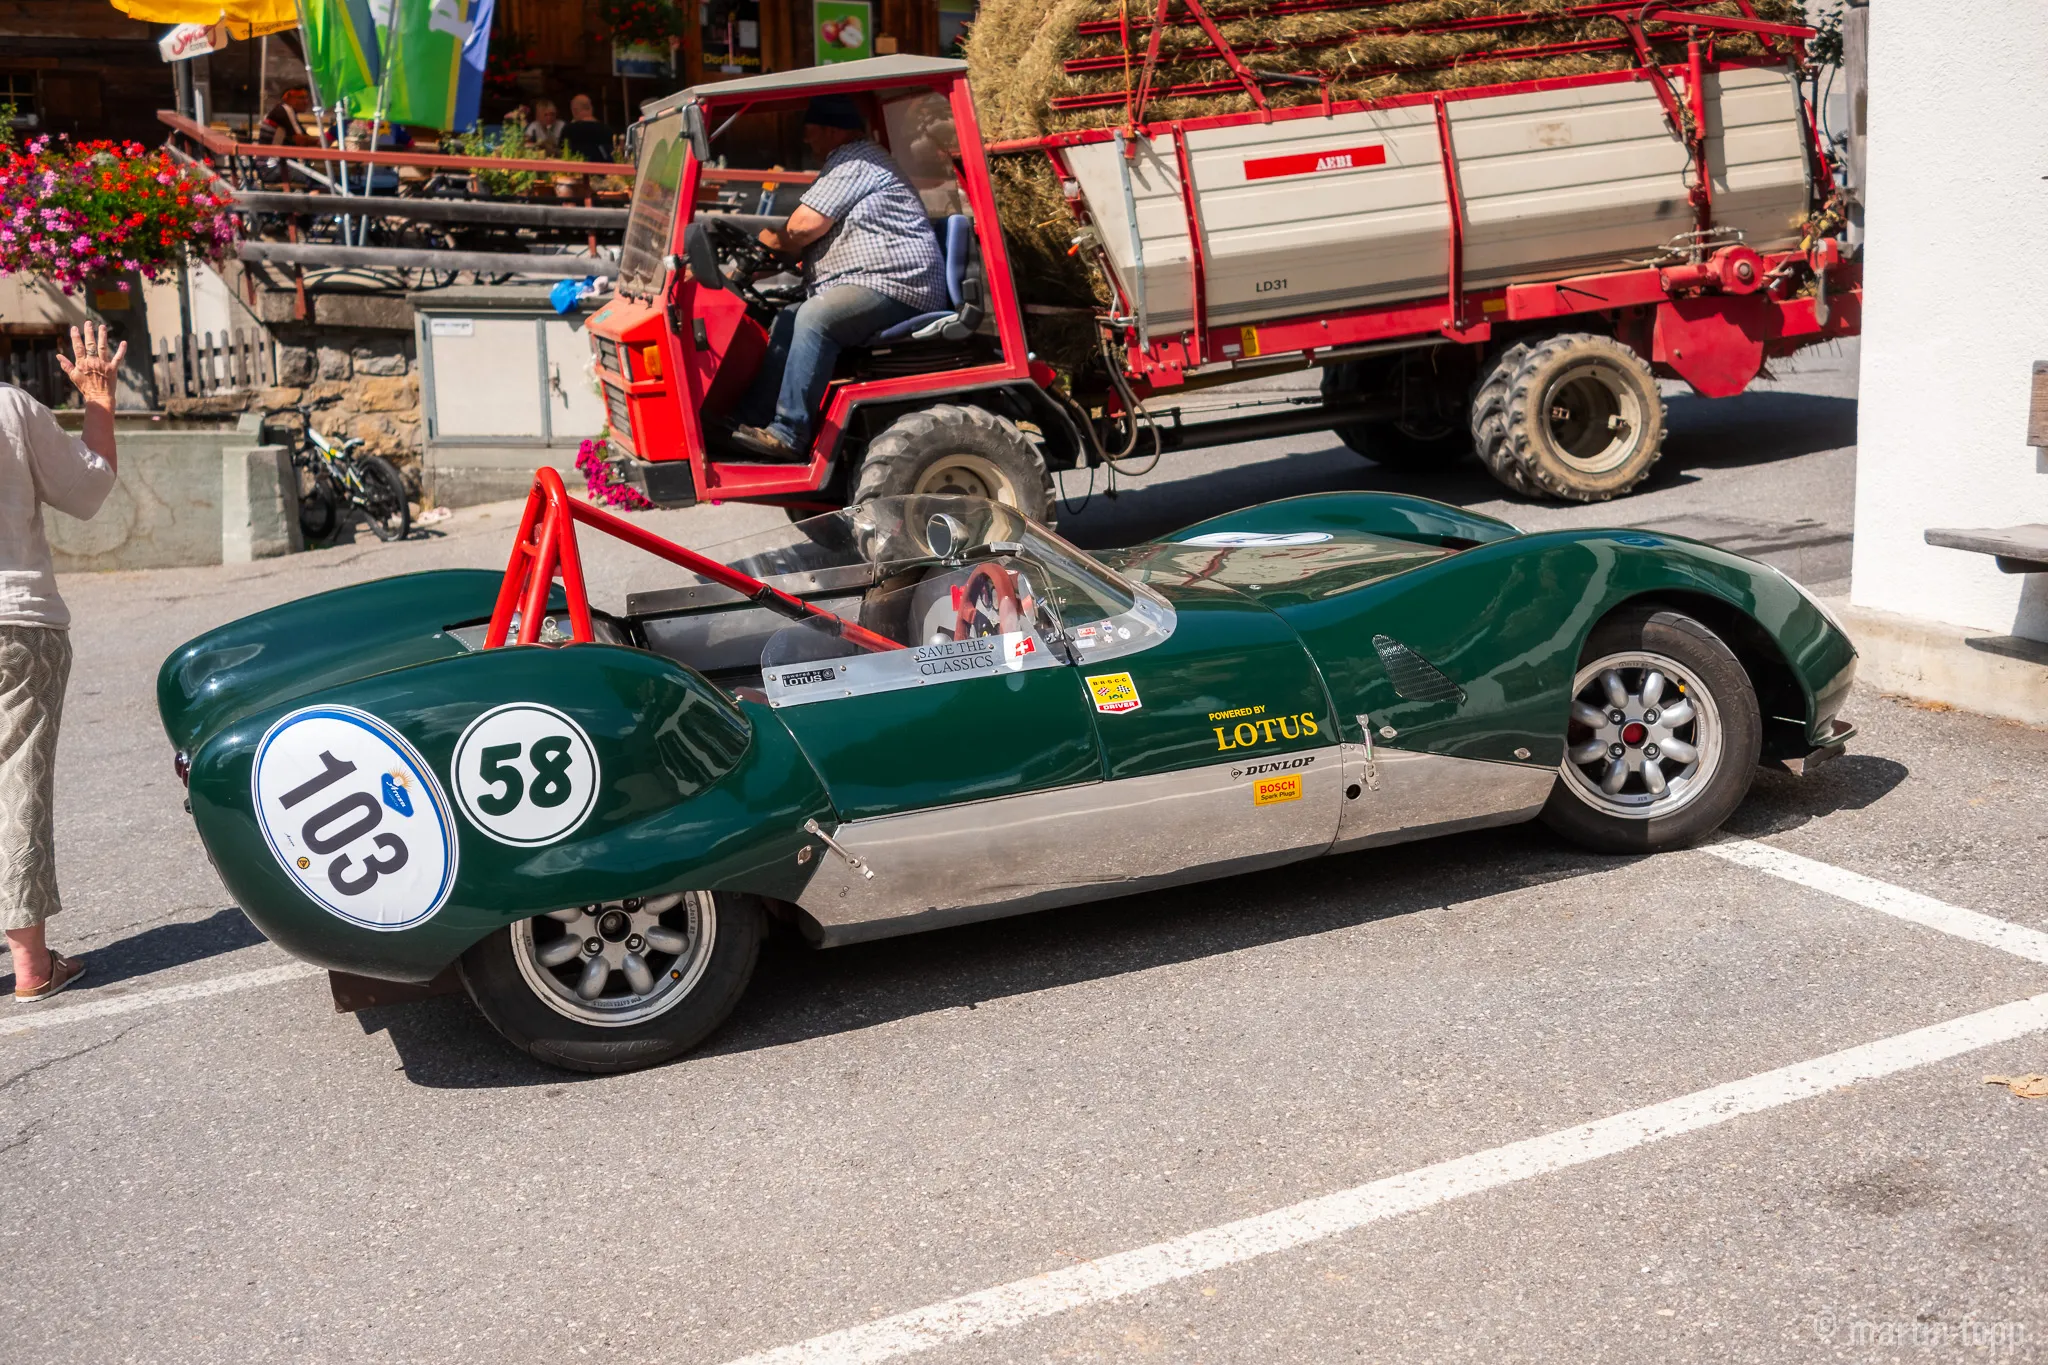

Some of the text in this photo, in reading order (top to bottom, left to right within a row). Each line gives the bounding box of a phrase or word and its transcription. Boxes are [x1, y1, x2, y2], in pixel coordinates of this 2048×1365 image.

[1316, 155, 1353, 170] AEBI
[1256, 279, 1287, 293] LD31
[918, 639, 987, 659] SAVE THE
[920, 654, 994, 676] CLASSICS
[783, 674, 823, 687] LOTUS
[1103, 701, 1135, 710] DRIVER
[1208, 704, 1266, 721] POWERED BY
[1213, 712, 1319, 751] LOTUS
[1245, 756, 1316, 776] DUNLOP
[477, 735, 573, 816] 58
[1260, 781, 1296, 794] BOSCH
[1261, 790, 1296, 801] Spark Plugs
[278, 750, 409, 896] 103
